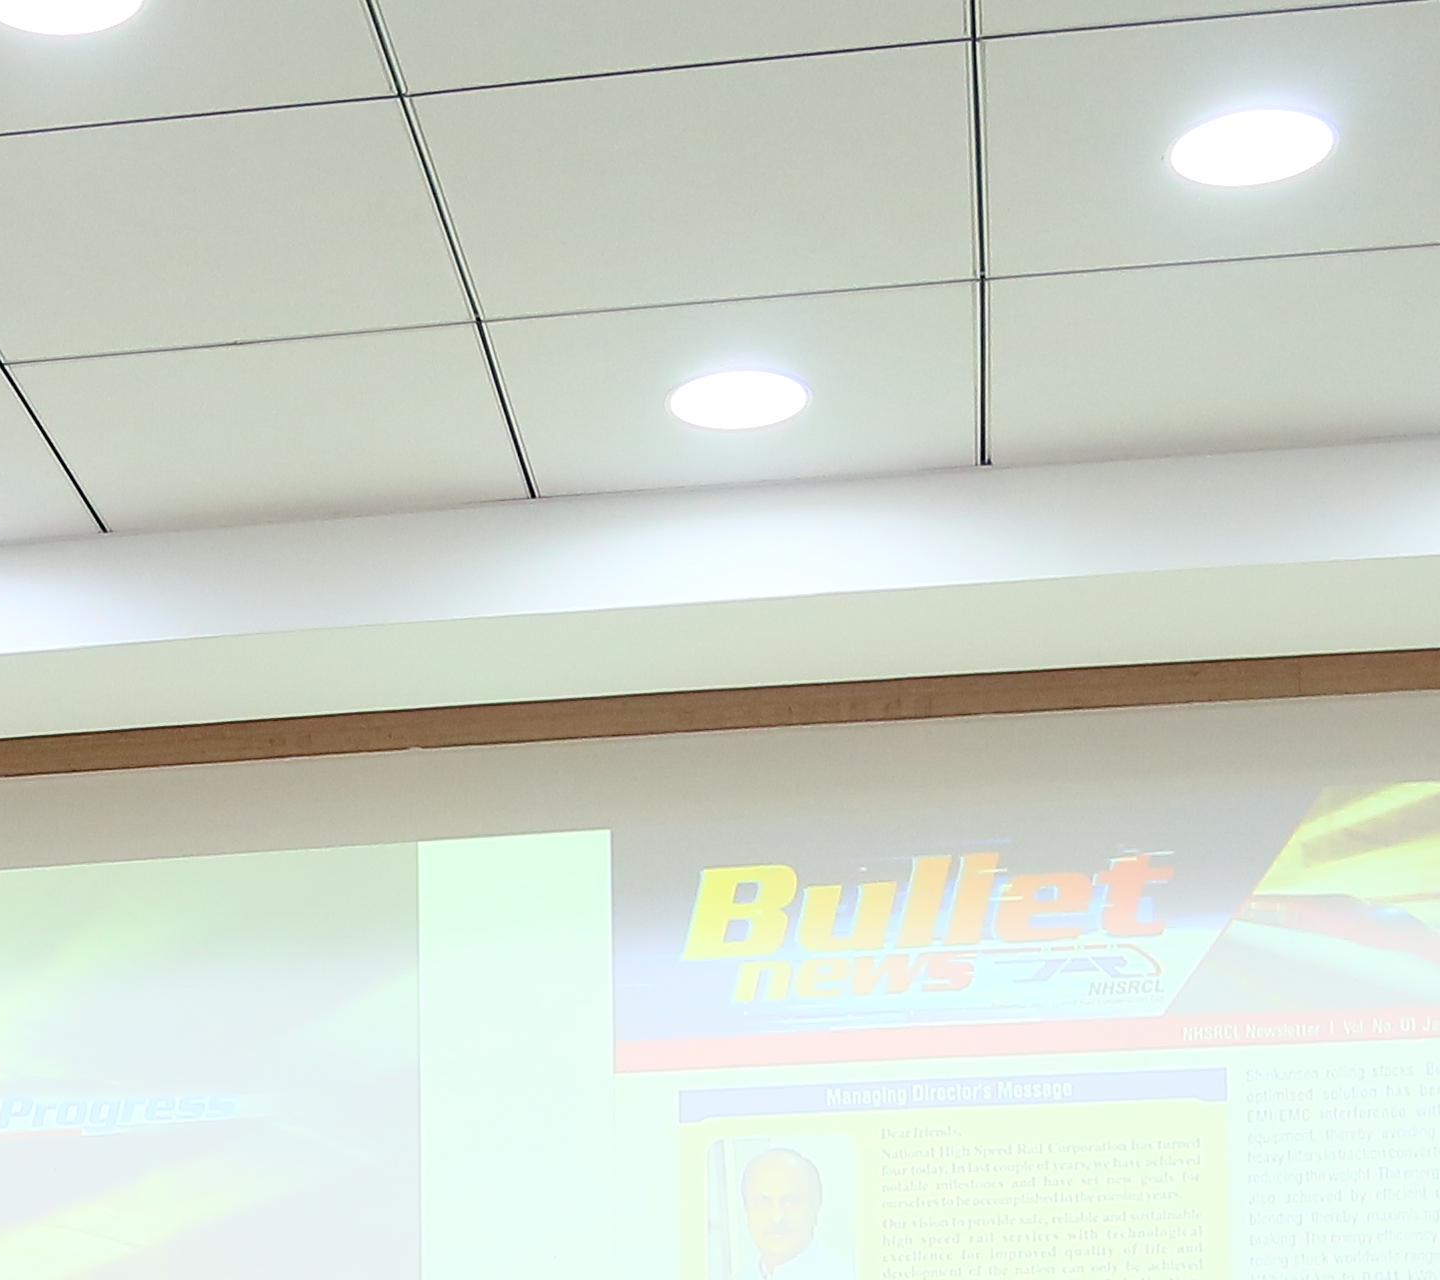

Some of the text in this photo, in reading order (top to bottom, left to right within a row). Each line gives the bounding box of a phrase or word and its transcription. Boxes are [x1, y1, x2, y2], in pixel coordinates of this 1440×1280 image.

[681, 851, 1175, 961] Bullet
[734, 951, 976, 1003] news
[1088, 979, 1164, 996] NHSRCL
[1182, 1024, 1238, 1041] NHSRCL
[1245, 1023, 1320, 1039] Newsletter
[826, 1080, 1073, 1108] Managing Director's Message
